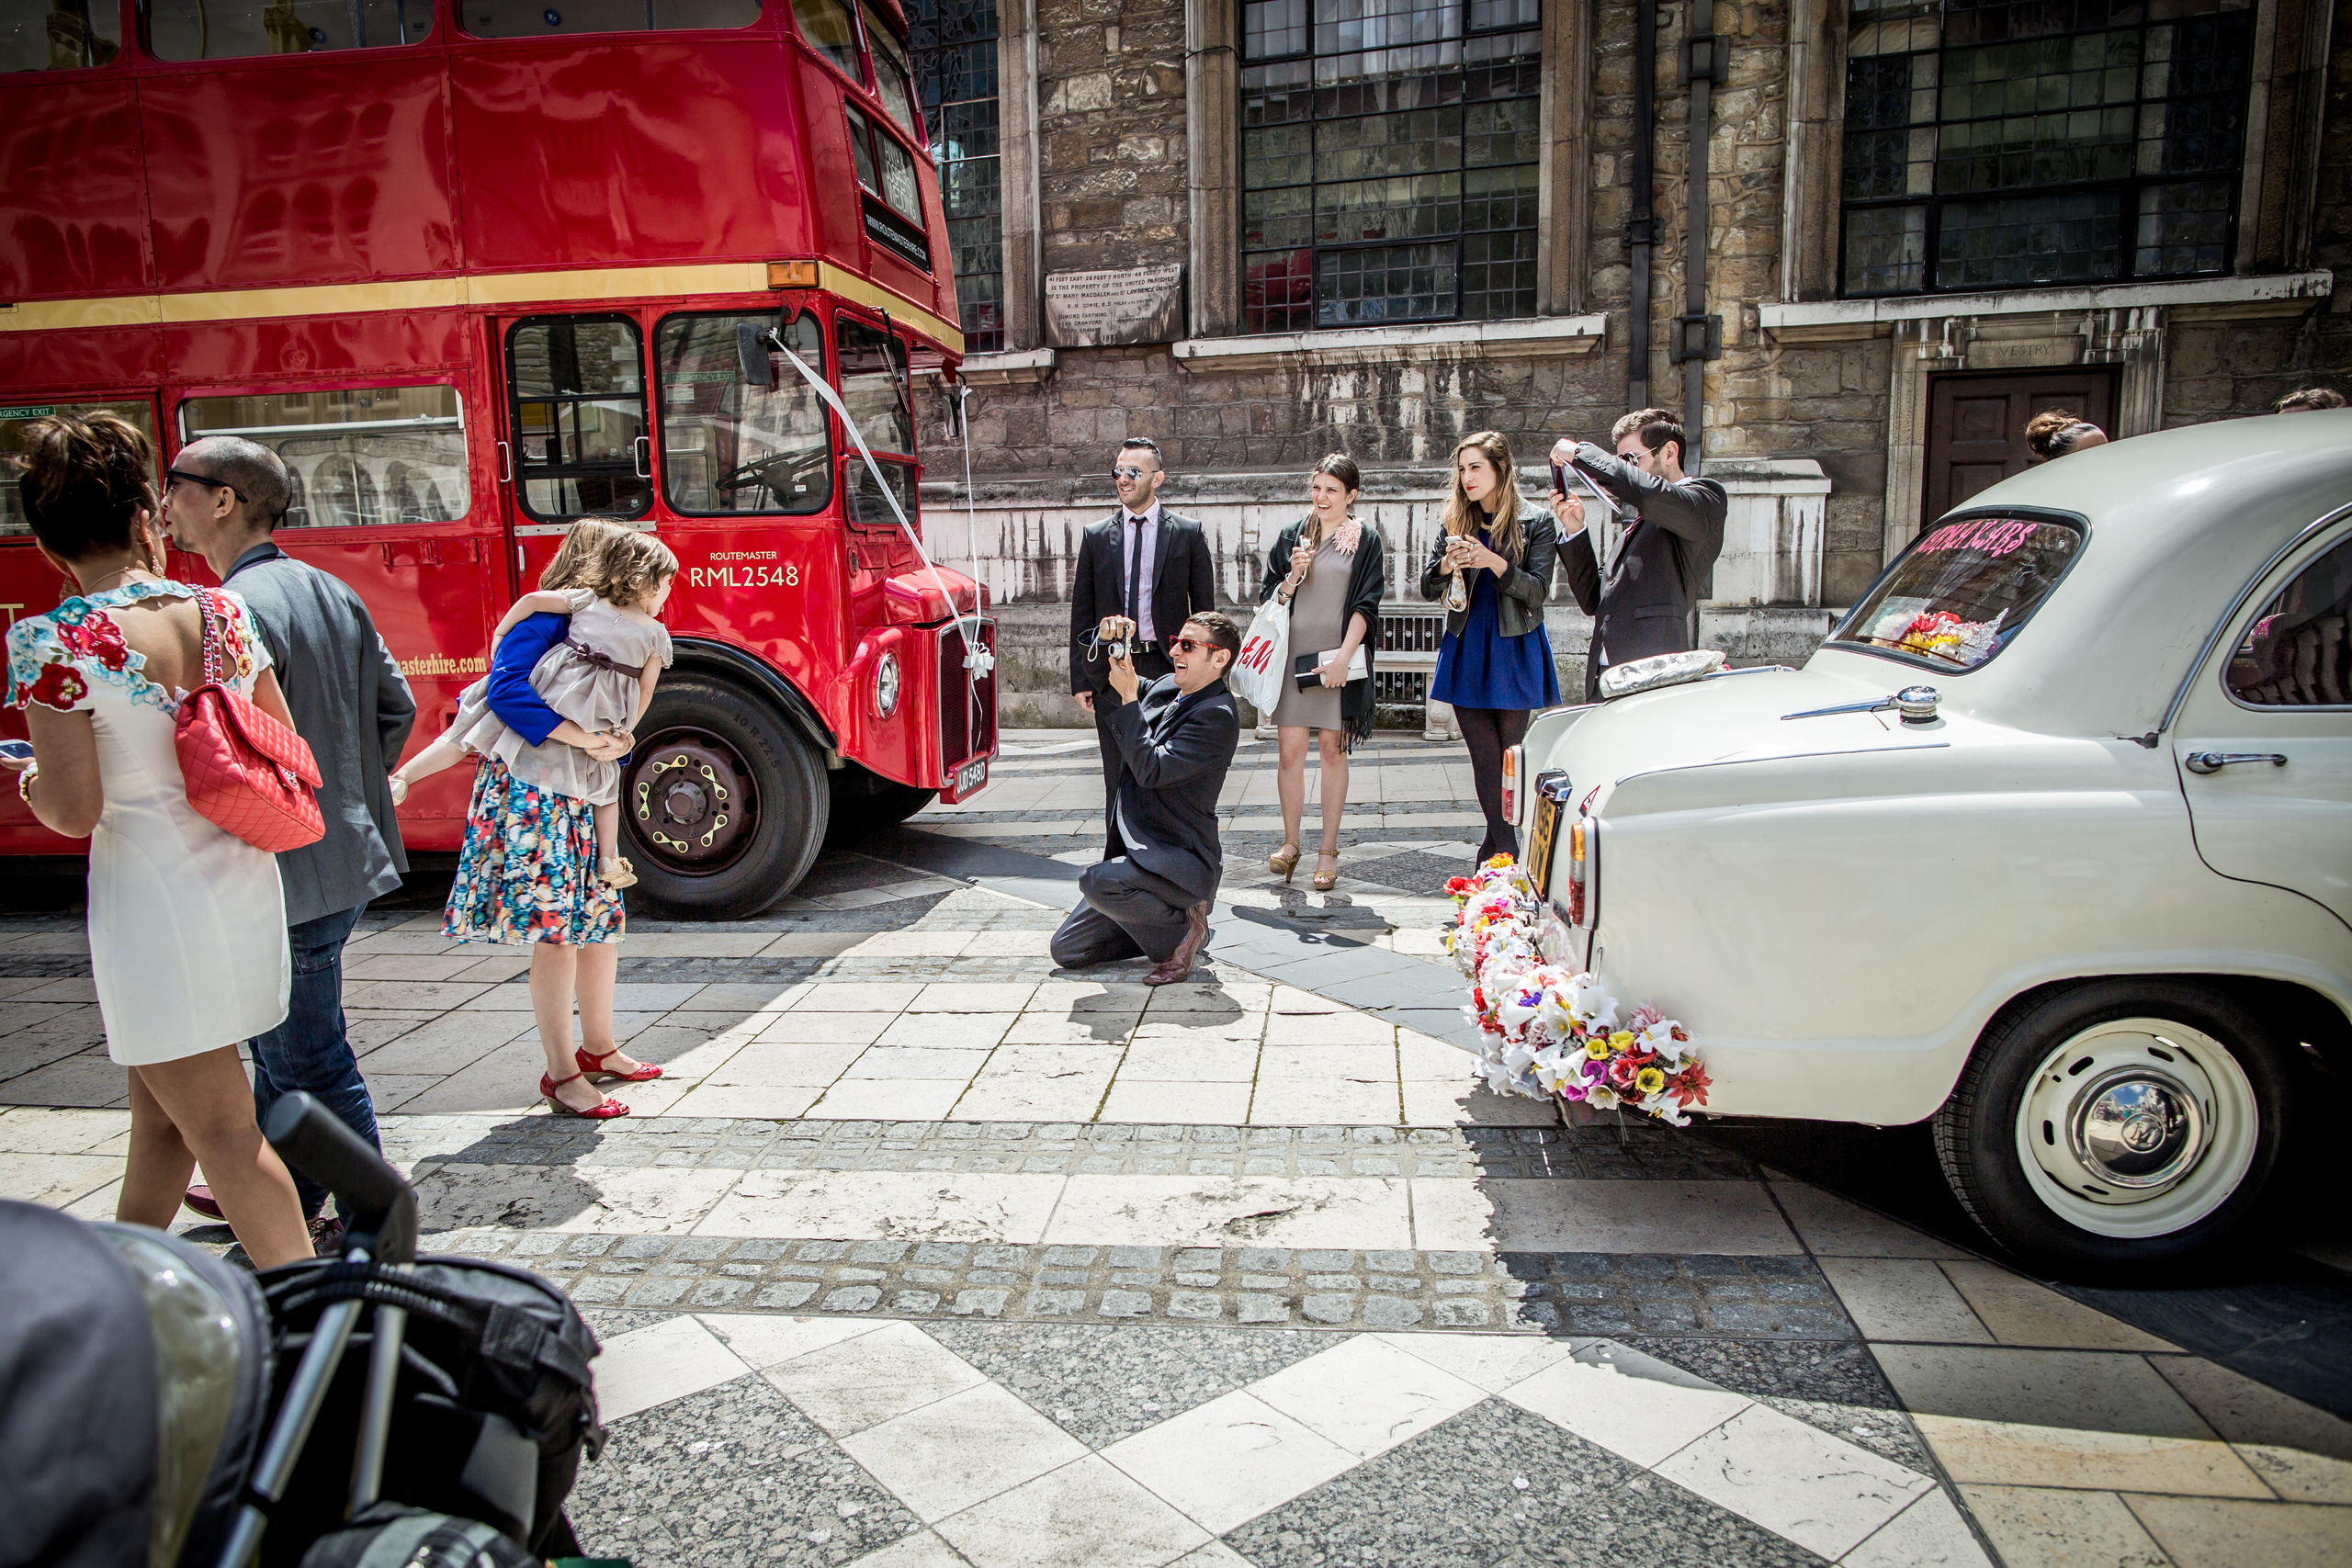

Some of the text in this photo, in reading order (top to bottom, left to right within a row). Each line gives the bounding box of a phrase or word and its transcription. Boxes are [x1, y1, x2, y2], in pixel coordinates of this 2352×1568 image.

[887, 179, 917, 220] WEDDING
[1147, 276, 1174, 285] PARISHES
[1126, 287, 1155, 296] LAWRENCE
[1998, 344, 2052, 356] VESTRY
[673, 373, 715, 381] EMERGENCY
[32, 408, 51, 416] EXIT
[710, 551, 777, 561] ROUTEMASTER
[690, 566, 799, 588] RML2548
[957, 761, 985, 794] JJD 548D
